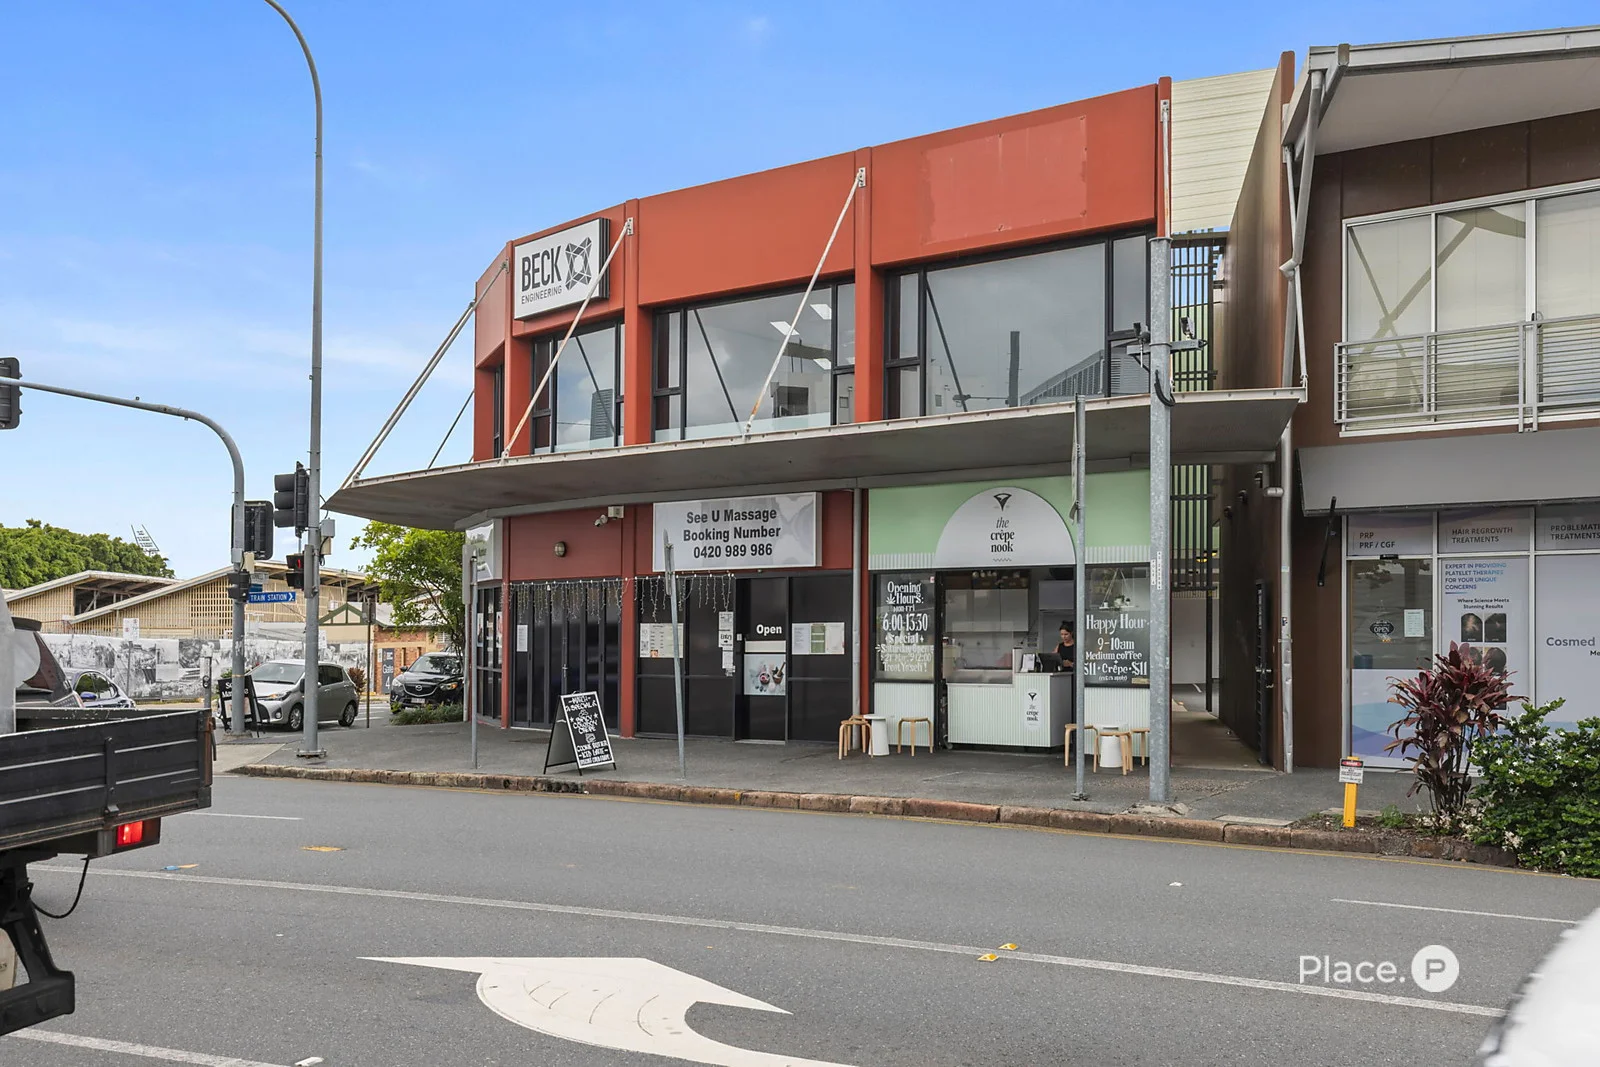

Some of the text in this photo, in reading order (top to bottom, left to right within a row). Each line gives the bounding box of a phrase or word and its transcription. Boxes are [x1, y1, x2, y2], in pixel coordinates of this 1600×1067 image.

[521, 245, 562, 292] BECK
[521, 285, 563, 305] ENGINEERING
[686, 509, 777, 524] See U Massage
[996, 517, 1010, 529] the
[683, 526, 781, 543] Booking Number
[990, 529, 1015, 543] crêpe
[1471, 527, 1513, 535] REGROWTH
[1359, 541, 1374, 549] PRF
[1452, 536, 1500, 544] TREATMENTS
[693, 543, 773, 559] 0420 989 986
[991, 541, 1014, 553] nook
[887, 581, 921, 596] Opening
[250, 593, 288, 602] TRAIN STATION
[756, 624, 783, 637] Open
[1086, 614, 1117, 635] Happy
[887, 632, 919, 645] Special
[1097, 637, 1135, 651] 9-10am
[1546, 636, 1596, 647] Cosmed
[1085, 650, 1143, 661] Medium coffee
[382, 664, 394, 674] Gate
[385, 676, 391, 690] 4
